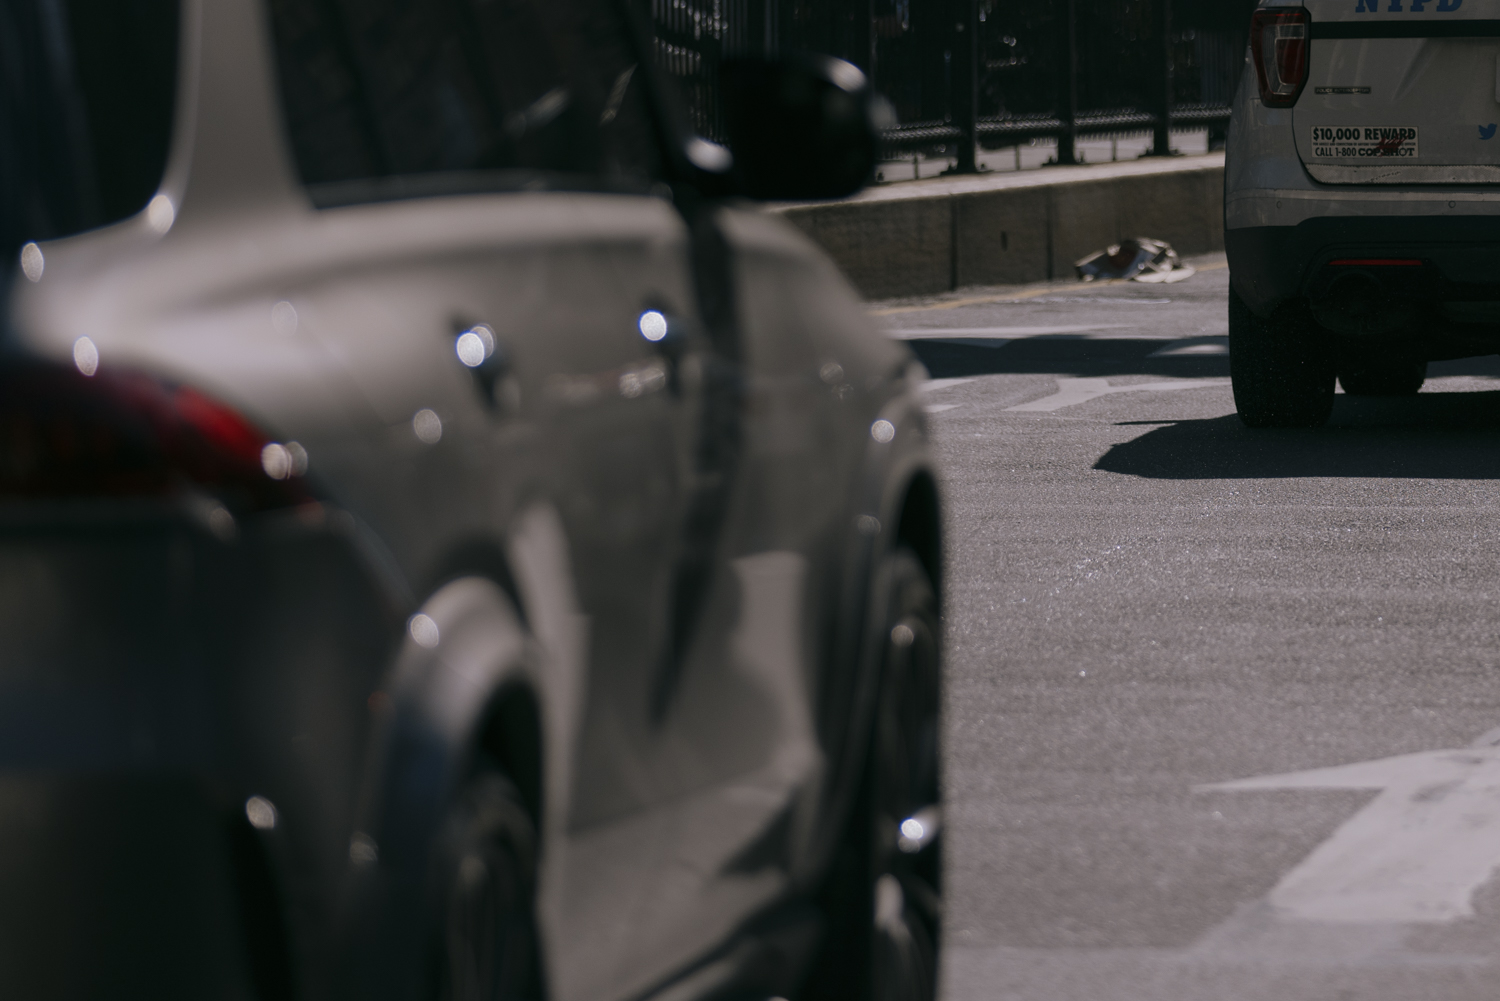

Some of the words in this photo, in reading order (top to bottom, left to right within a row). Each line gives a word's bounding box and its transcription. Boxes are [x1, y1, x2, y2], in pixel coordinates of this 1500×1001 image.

[1313, 127, 1360, 142] $10,000
[1364, 128, 1416, 140] REWARD
[1315, 147, 1333, 157] CALL
[1335, 147, 1356, 157] 1-800
